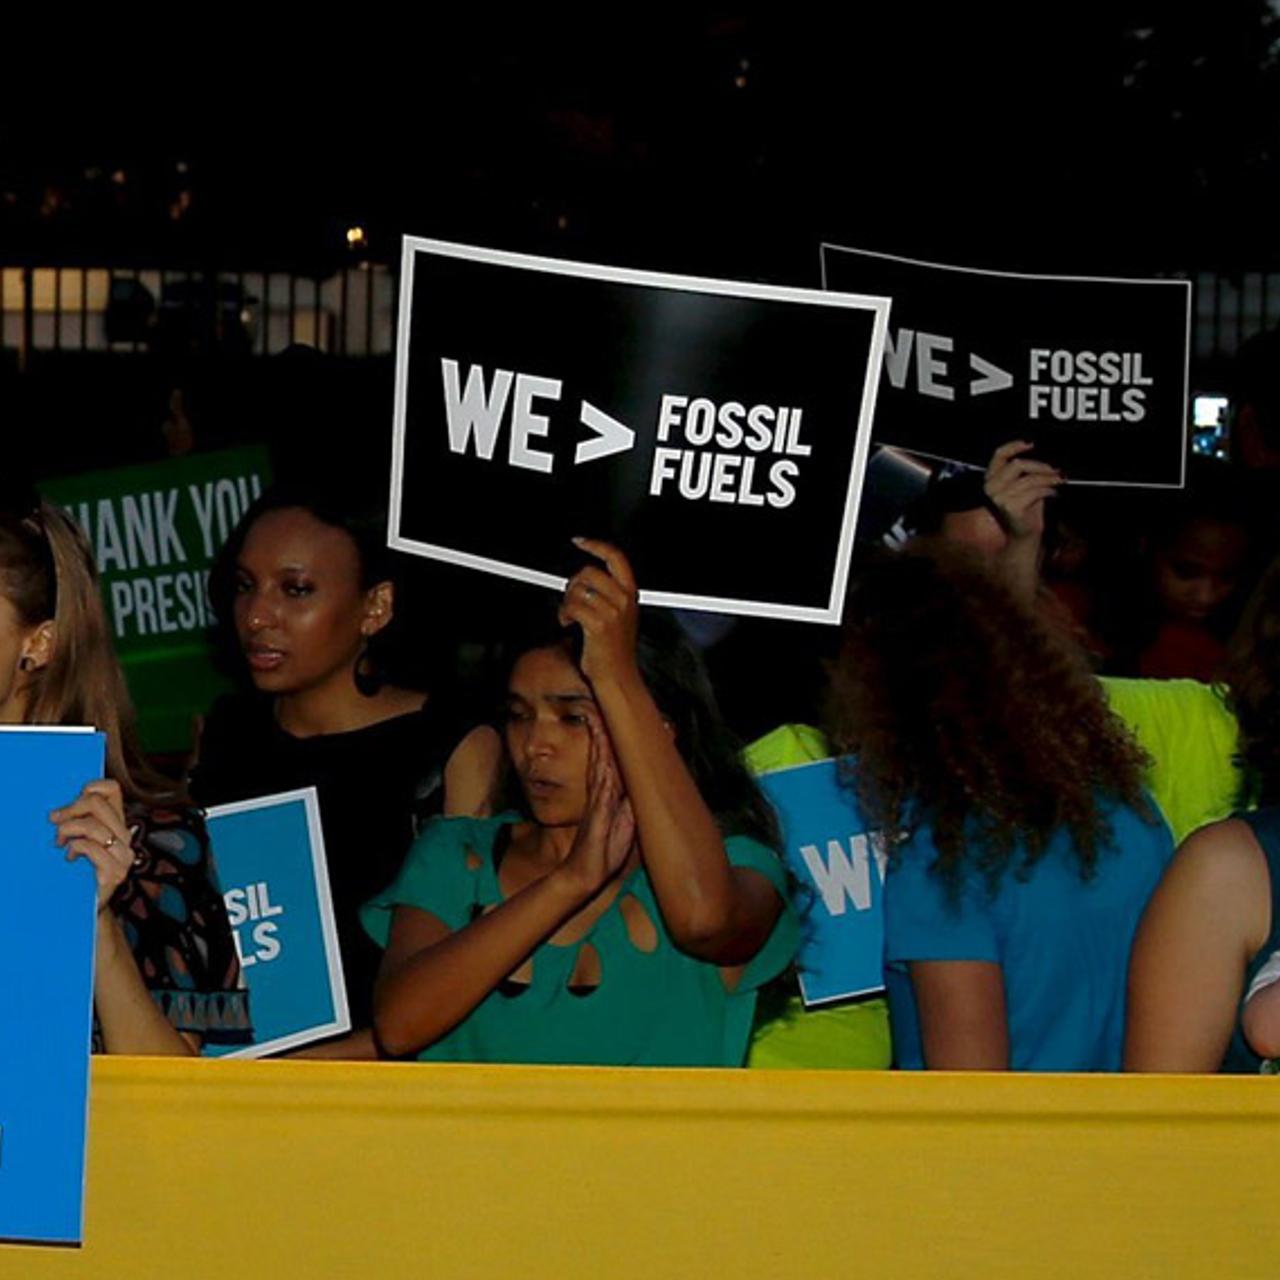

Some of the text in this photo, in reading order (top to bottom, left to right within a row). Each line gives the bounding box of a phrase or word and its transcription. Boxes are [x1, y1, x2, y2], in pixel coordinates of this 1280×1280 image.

[1029, 347, 1155, 386] FOSSIL
[440, 356, 564, 474] WE
[655, 393, 813, 458] FOSSIL
[1028, 384, 1148, 423] FUELS
[648, 446, 801, 510] FUELS
[64, 487, 188, 574] ANK
[799, 832, 889, 917] W
